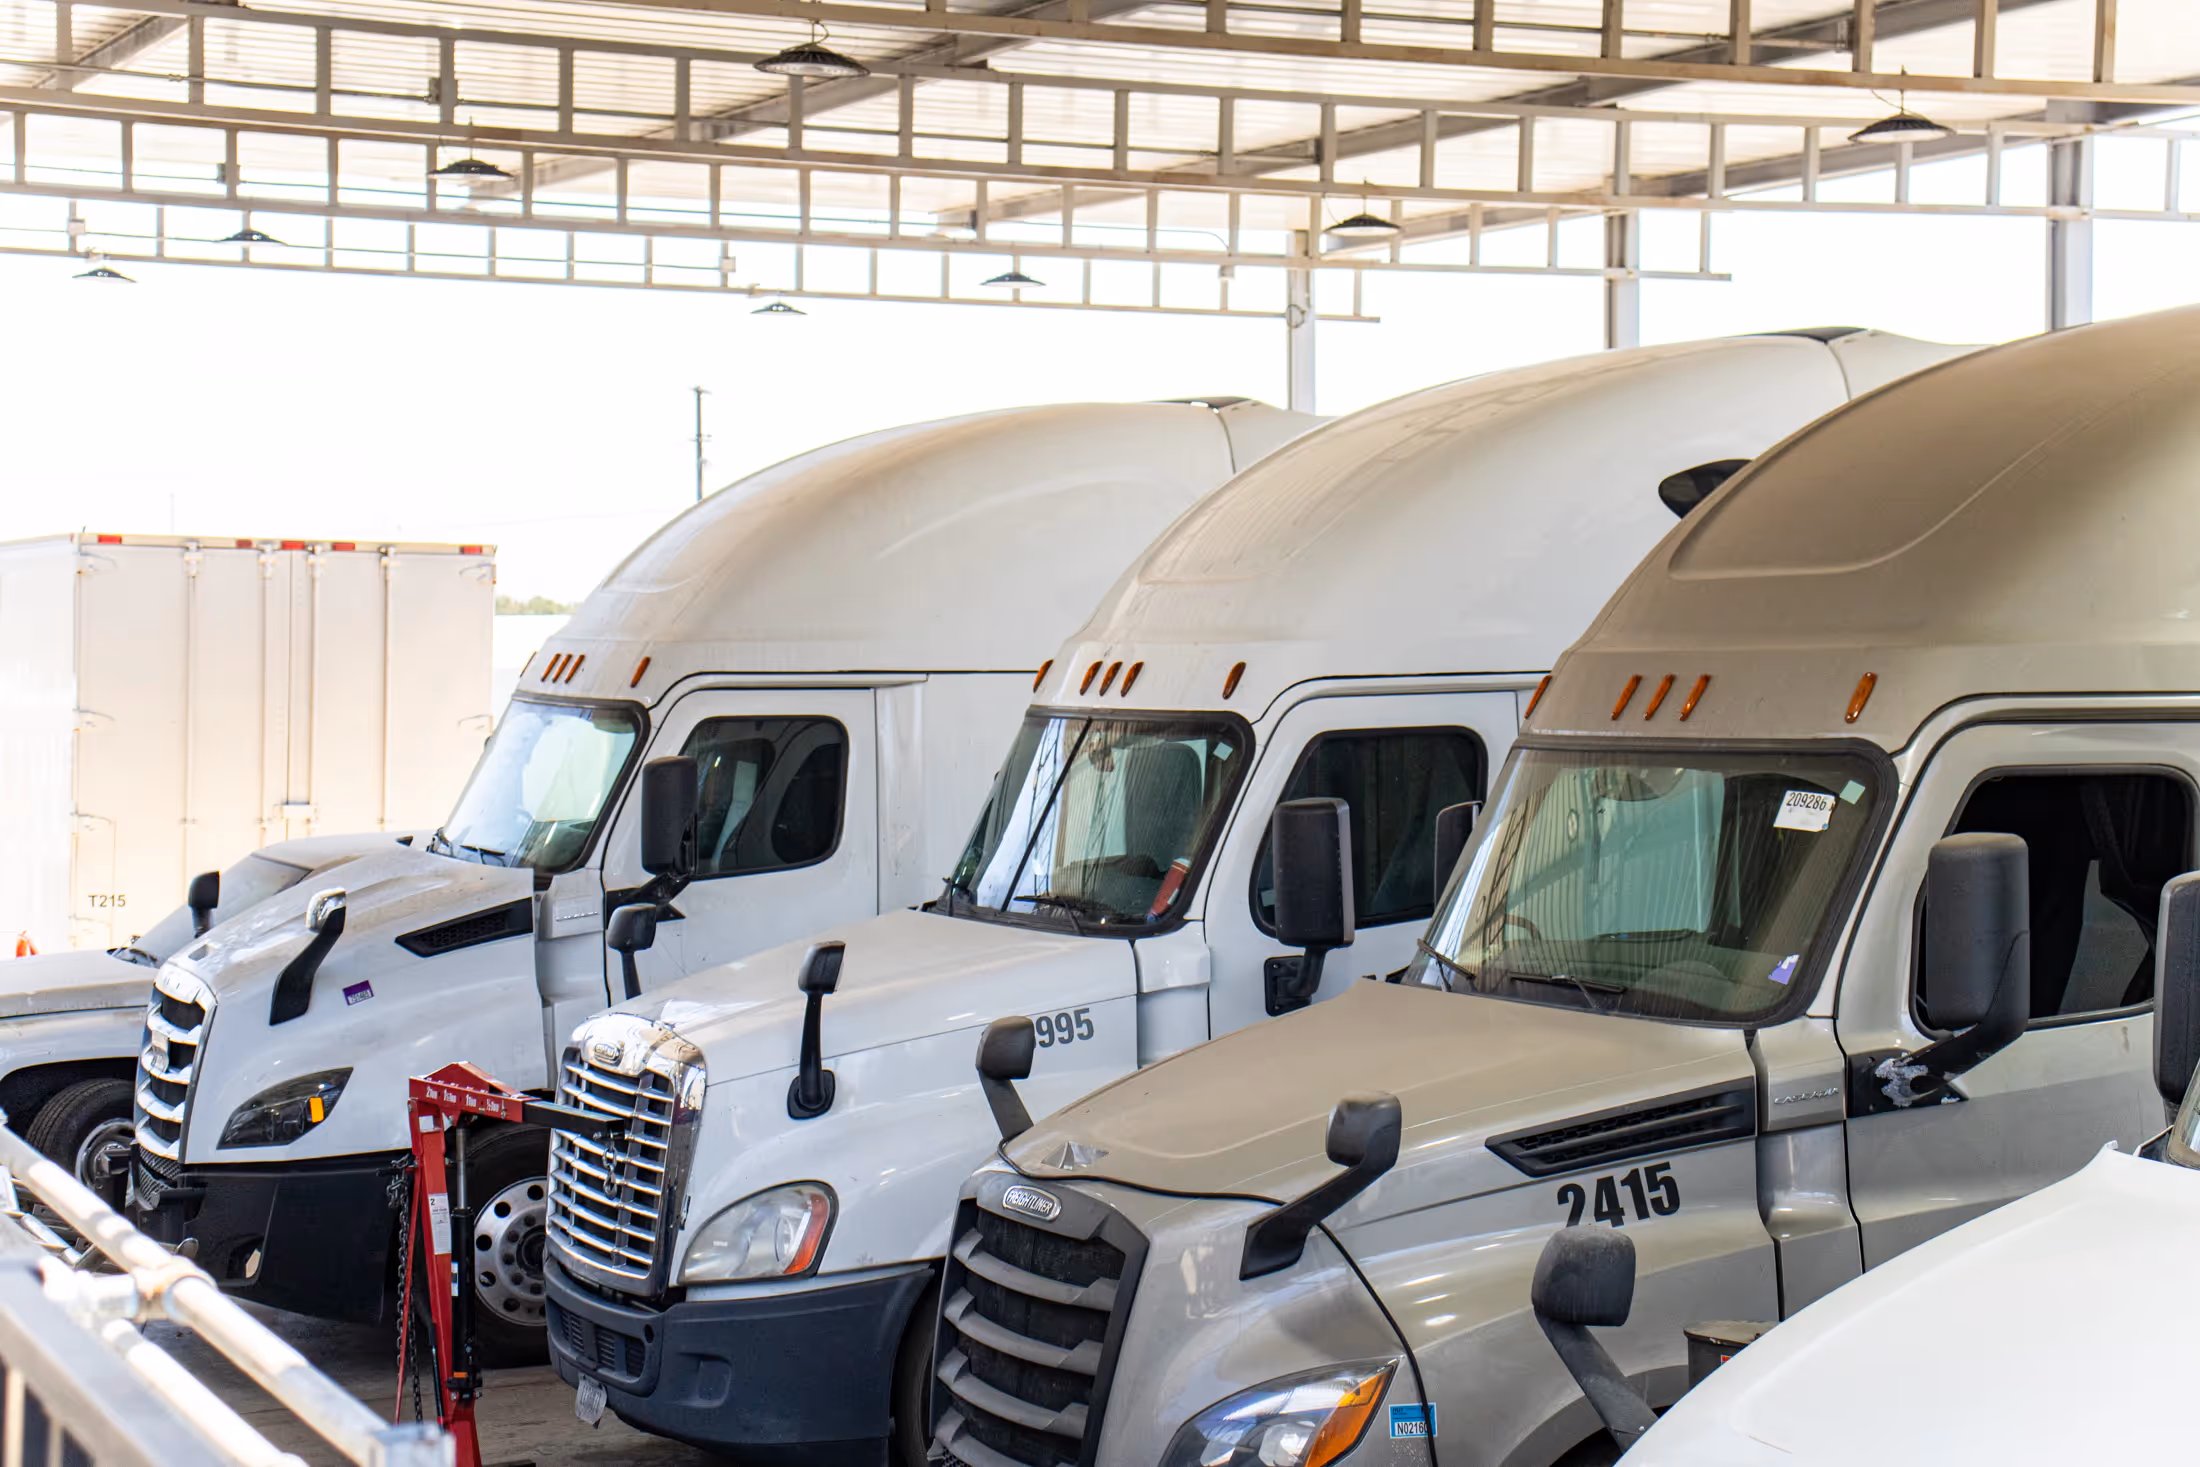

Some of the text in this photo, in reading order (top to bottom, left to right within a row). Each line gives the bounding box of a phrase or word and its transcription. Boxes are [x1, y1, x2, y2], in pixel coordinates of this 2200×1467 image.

[1786, 792, 1827, 811] 209286
[88, 894, 126, 908] T215
[1035, 1007, 1094, 1048] 995
[1006, 1189, 1053, 1214] FREIGHTLINER
[1557, 1161, 1680, 1228] 2415
